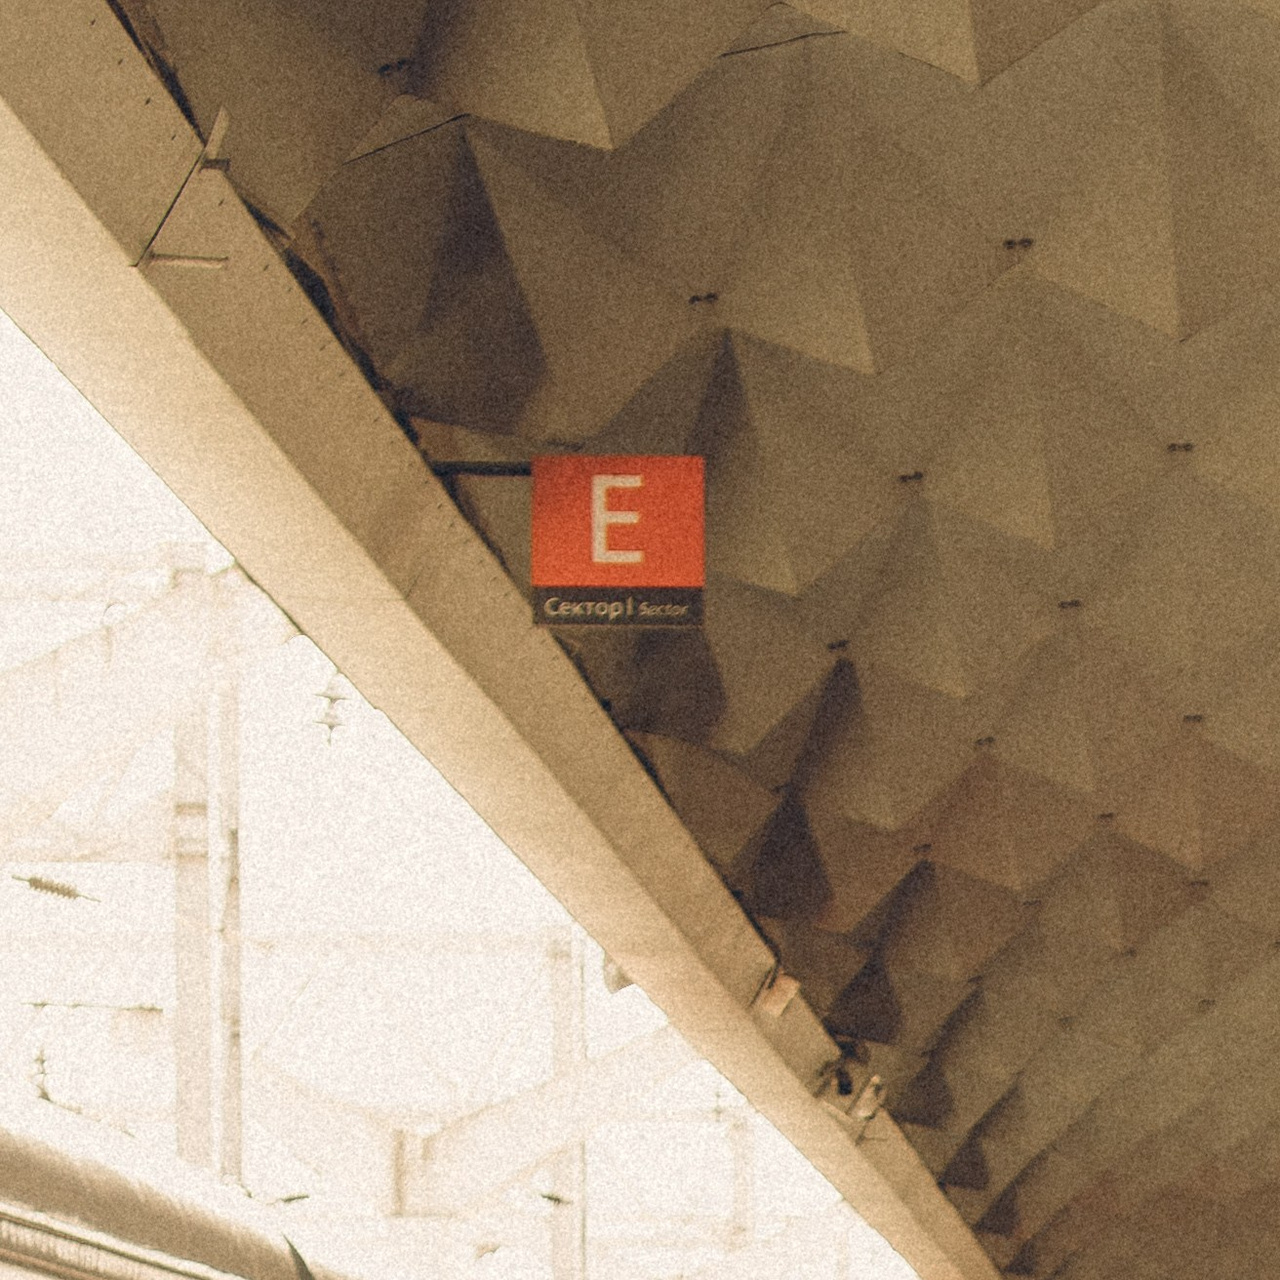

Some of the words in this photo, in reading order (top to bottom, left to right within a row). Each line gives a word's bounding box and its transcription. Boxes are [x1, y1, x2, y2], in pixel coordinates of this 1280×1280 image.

[592, 474, 643, 563] E
[543, 597, 624, 620] Сектор
[639, 600, 688, 616] Sector
